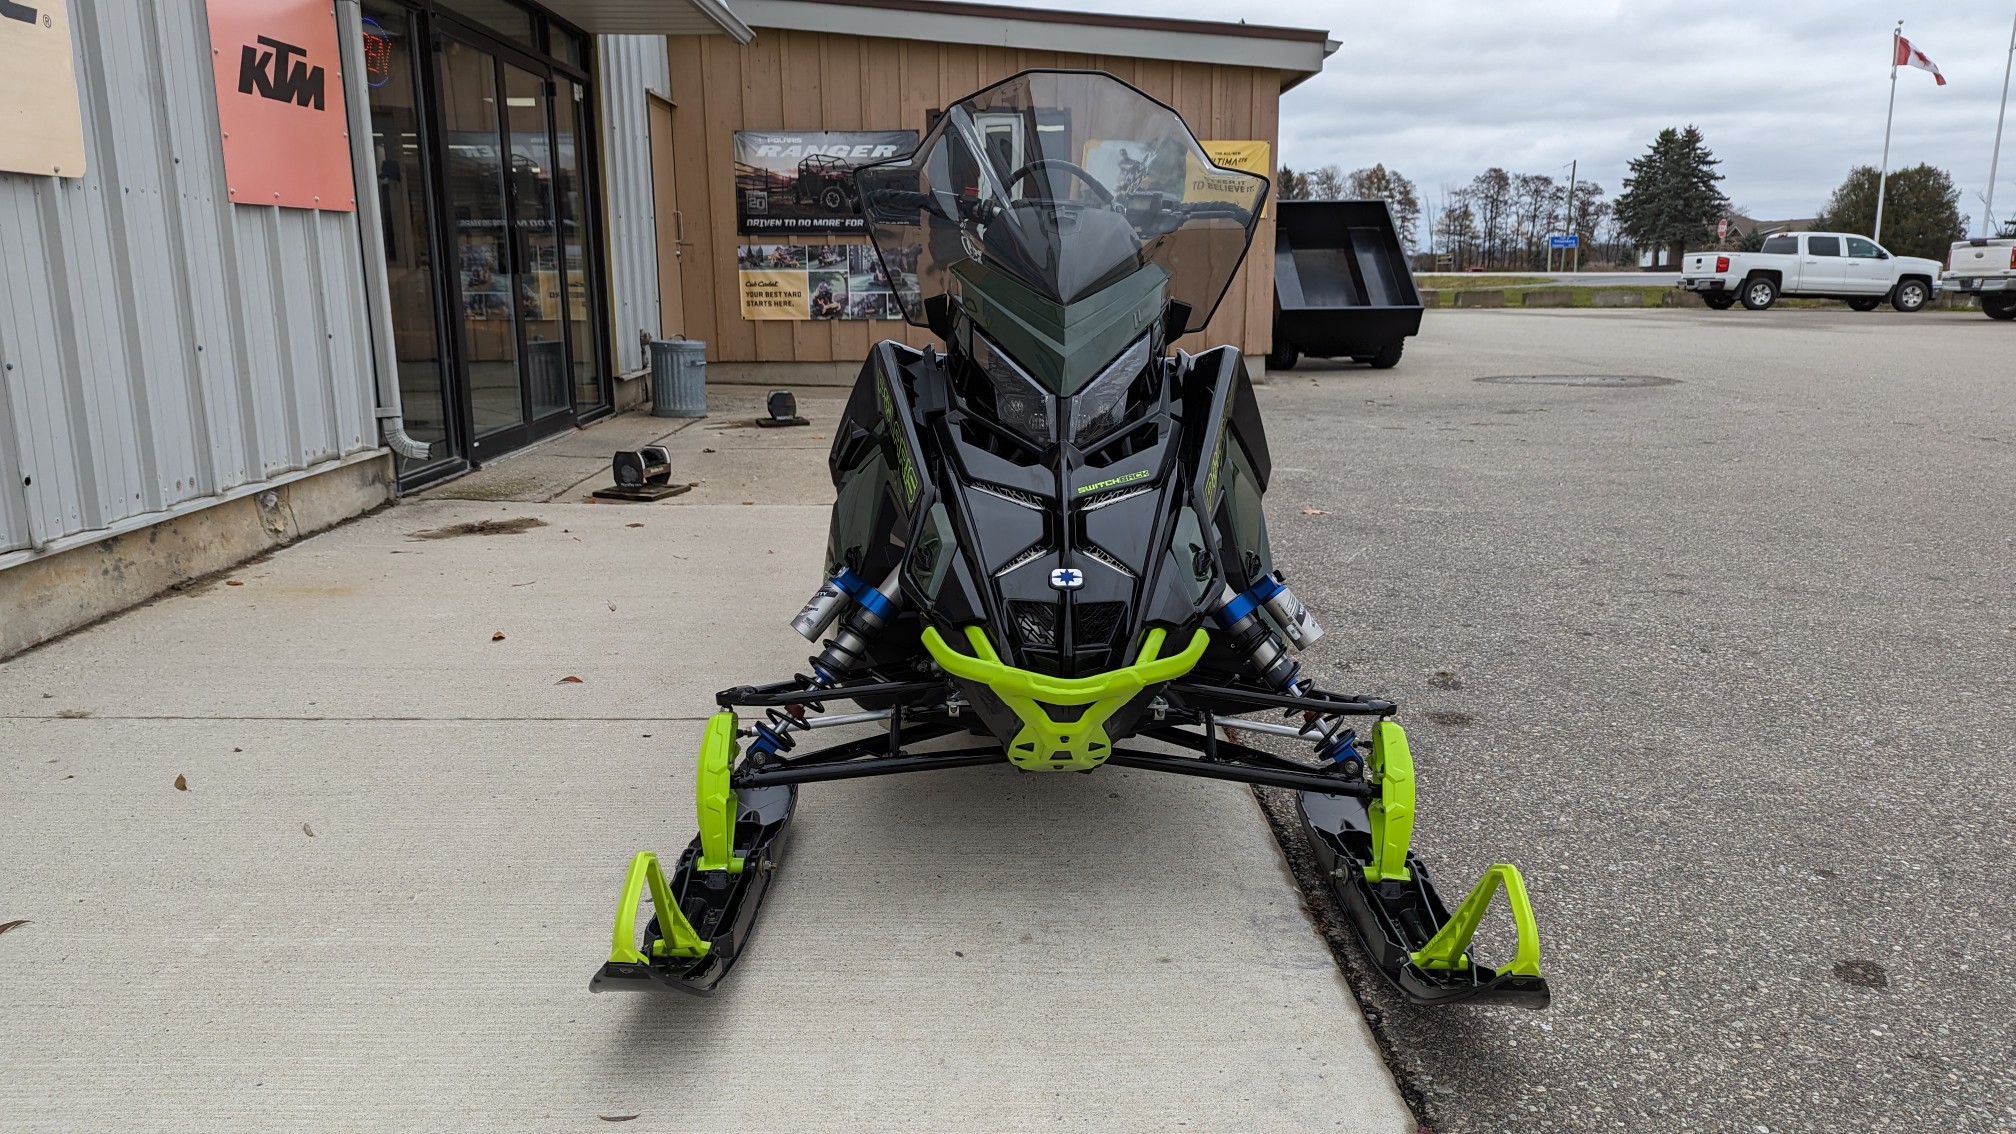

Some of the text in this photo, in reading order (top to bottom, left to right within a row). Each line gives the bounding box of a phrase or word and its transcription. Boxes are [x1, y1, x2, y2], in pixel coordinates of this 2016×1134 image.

[237, 34, 326, 111] KTM
[756, 145, 897, 157] RANGER
[1207, 182, 1245, 193] BELIEVE
[748, 197, 766, 209] 20
[746, 218, 784, 228] DRIVEN
[783, 218, 797, 227] TO
[798, 218, 811, 227] DO
[845, 218, 864, 227] FOR
[1077, 469, 1150, 494] SWITCHBACK
